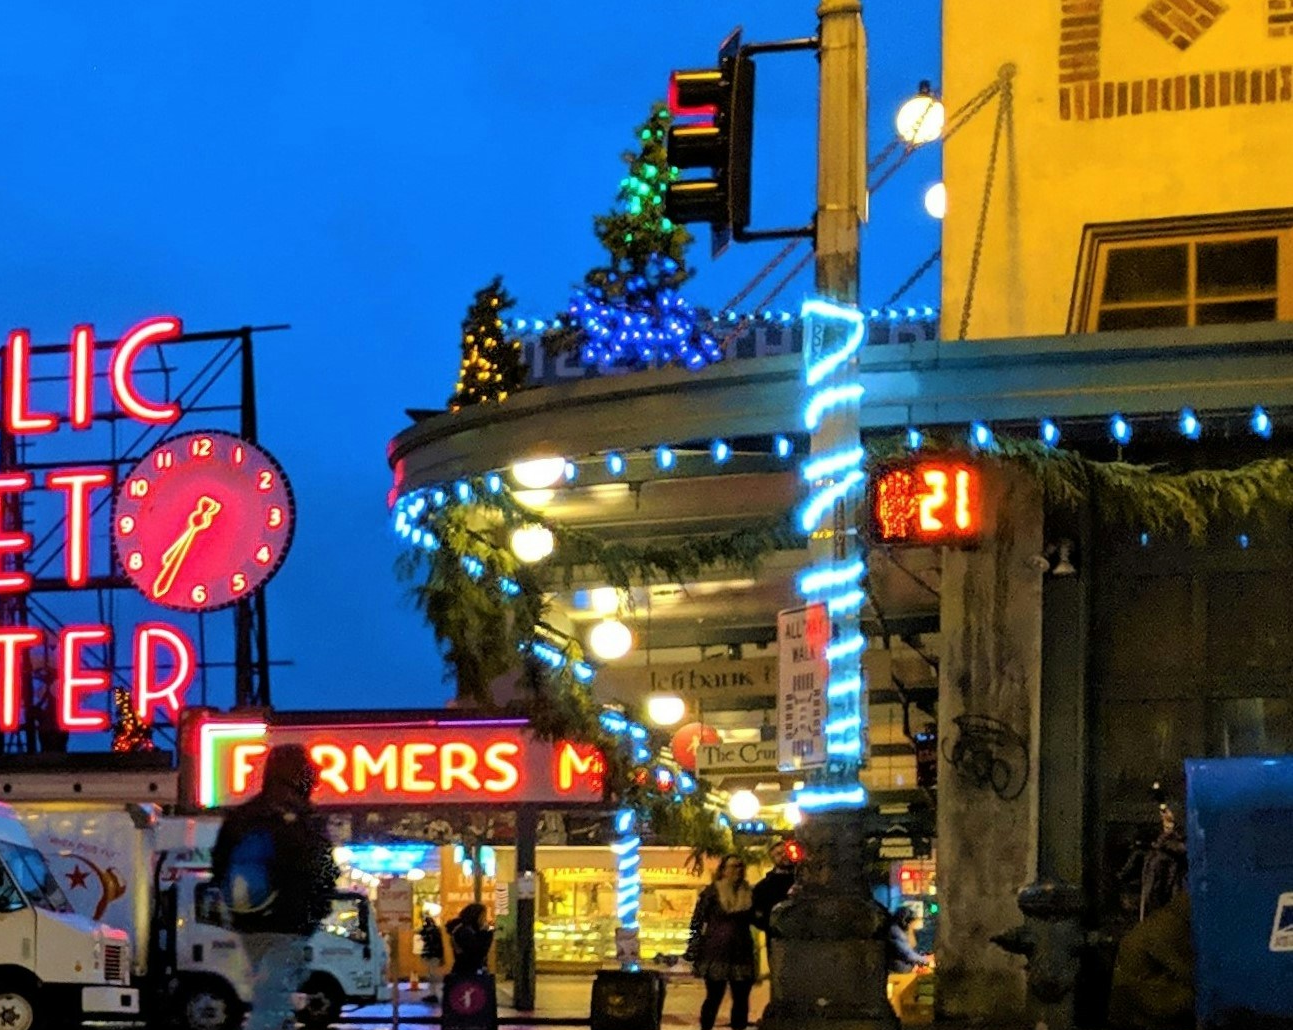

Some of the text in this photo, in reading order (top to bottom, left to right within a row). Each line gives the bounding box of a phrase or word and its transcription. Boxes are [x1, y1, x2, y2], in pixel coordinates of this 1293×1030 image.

[192, 438, 213, 457] 12
[156, 451, 172, 469] 11
[129, 478, 149, 497] 10
[259, 471, 273, 490] 2
[920, 468, 970, 531] 21
[119, 515, 135, 534] 9
[268, 507, 282, 527] 3
[128, 552, 144, 571] 8
[256, 546, 270, 563] 4
[232, 573, 246, 591] 5
[191, 585, 207, 604] 6
[786, 621, 802, 639] ALL
[703, 745, 735, 765] The
[231, 742, 520, 794] FRMERS
